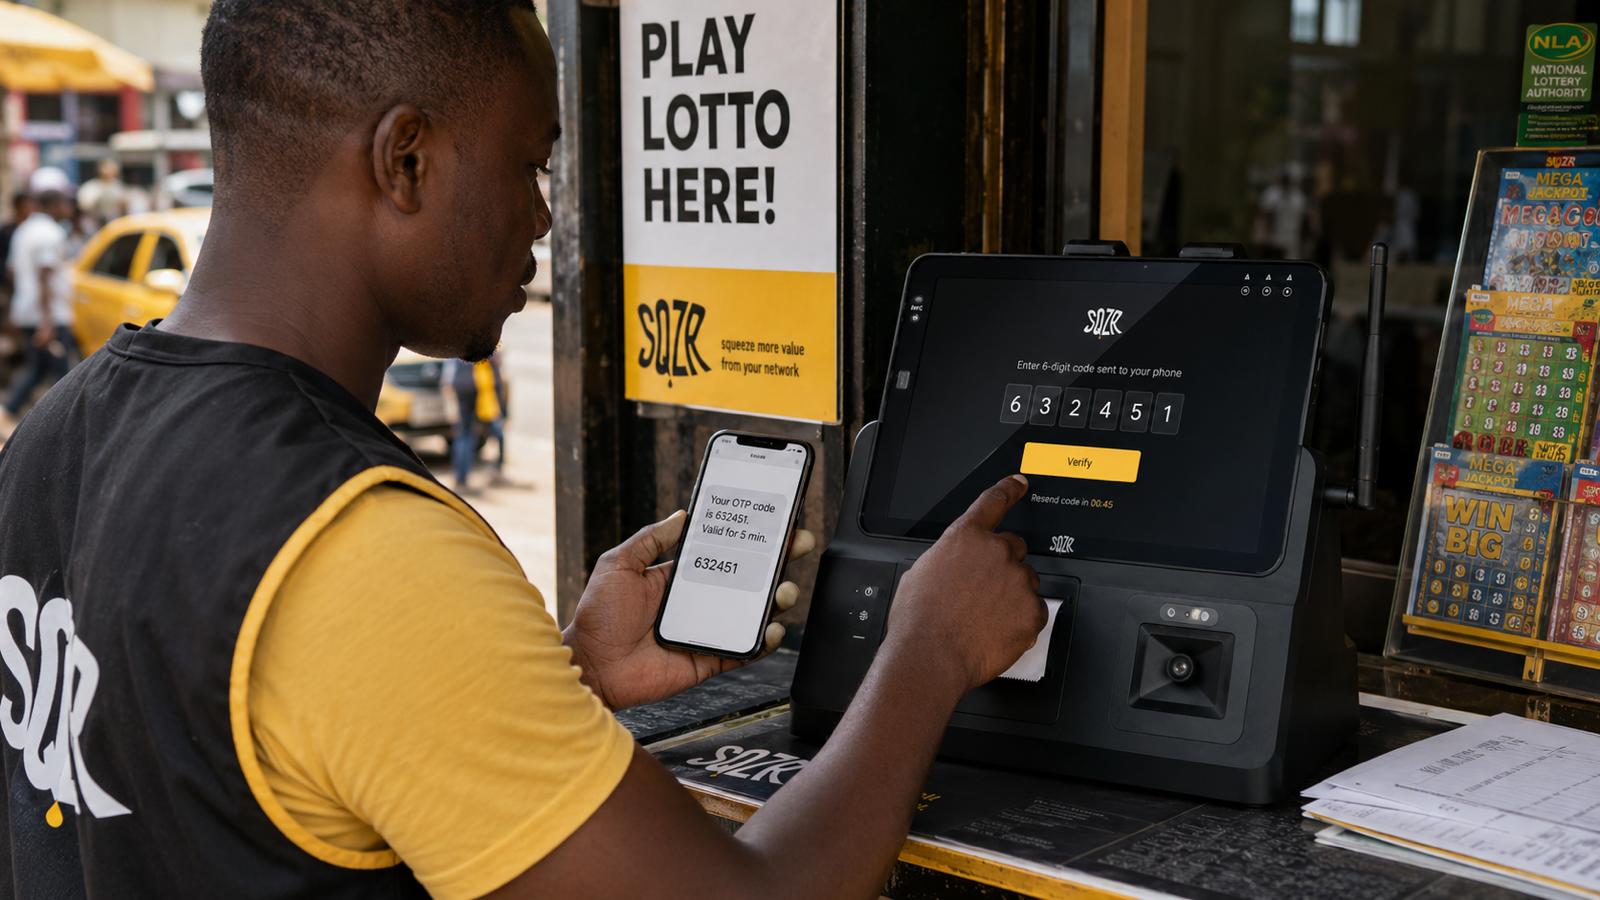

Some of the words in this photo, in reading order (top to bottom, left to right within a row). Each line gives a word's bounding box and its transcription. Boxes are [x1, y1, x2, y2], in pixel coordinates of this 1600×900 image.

[641, 13, 756, 79] PLAY
[1534, 35, 1581, 48] NLA
[1531, 65, 1587, 74] NATIONAL
[1534, 77, 1581, 86] LOTTERY
[1526, 88, 1587, 98] AUTHORITY
[643, 89, 790, 151] LOTTO
[1535, 172, 1583, 187] MEGA
[644, 166, 776, 225] HERE!
[1527, 186, 1588, 199] JACKPOT
[1083, 307, 1122, 336] SQZR
[638, 298, 712, 378] SQZR
[721, 337, 755, 354] squeeze
[757, 341, 779, 354] more
[781, 340, 805, 356] value
[721, 358, 741, 373] from
[743, 362, 761, 376] your
[764, 362, 800, 377] network
[1016, 360, 1040, 371] Enter
[1042, 361, 1071, 375] 6-digit
[1072, 363, 1094, 375] code
[1097, 365, 1117, 376] sent
[1119, 366, 1129, 376] to
[1131, 368, 1151, 379] your
[1153, 367, 1182, 380] phone
[1010, 396, 1021, 413] 6
[1039, 397, 1051, 415] 3
[1069, 400, 1081, 417] 2
[1099, 402, 1112, 419] 4
[1131, 404, 1142, 421] 5
[1163, 405, 1172, 422] 1
[1067, 456, 1093, 469] Verify
[1470, 458, 1516, 475] MEGA
[1465, 472, 1518, 488] JACKPOT
[710, 495, 731, 507] Your
[732, 498, 751, 508] OTP
[753, 502, 776, 514] code
[1031, 493, 1058, 506] Resend
[1060, 496, 1080, 507] code
[1081, 497, 1089, 507] in
[1090, 498, 1114, 509] 00:45
[706, 509, 714, 519] is
[715, 511, 749, 525] 632451.
[1444, 495, 1515, 533] WIN
[702, 524, 724, 537] Valid
[726, 528, 740, 540] for
[740, 530, 747, 540] 5
[748, 532, 767, 544] min.
[1445, 525, 1504, 561] BIG
[1049, 534, 1075, 554] SQZR
[694, 556, 738, 575] 632451
